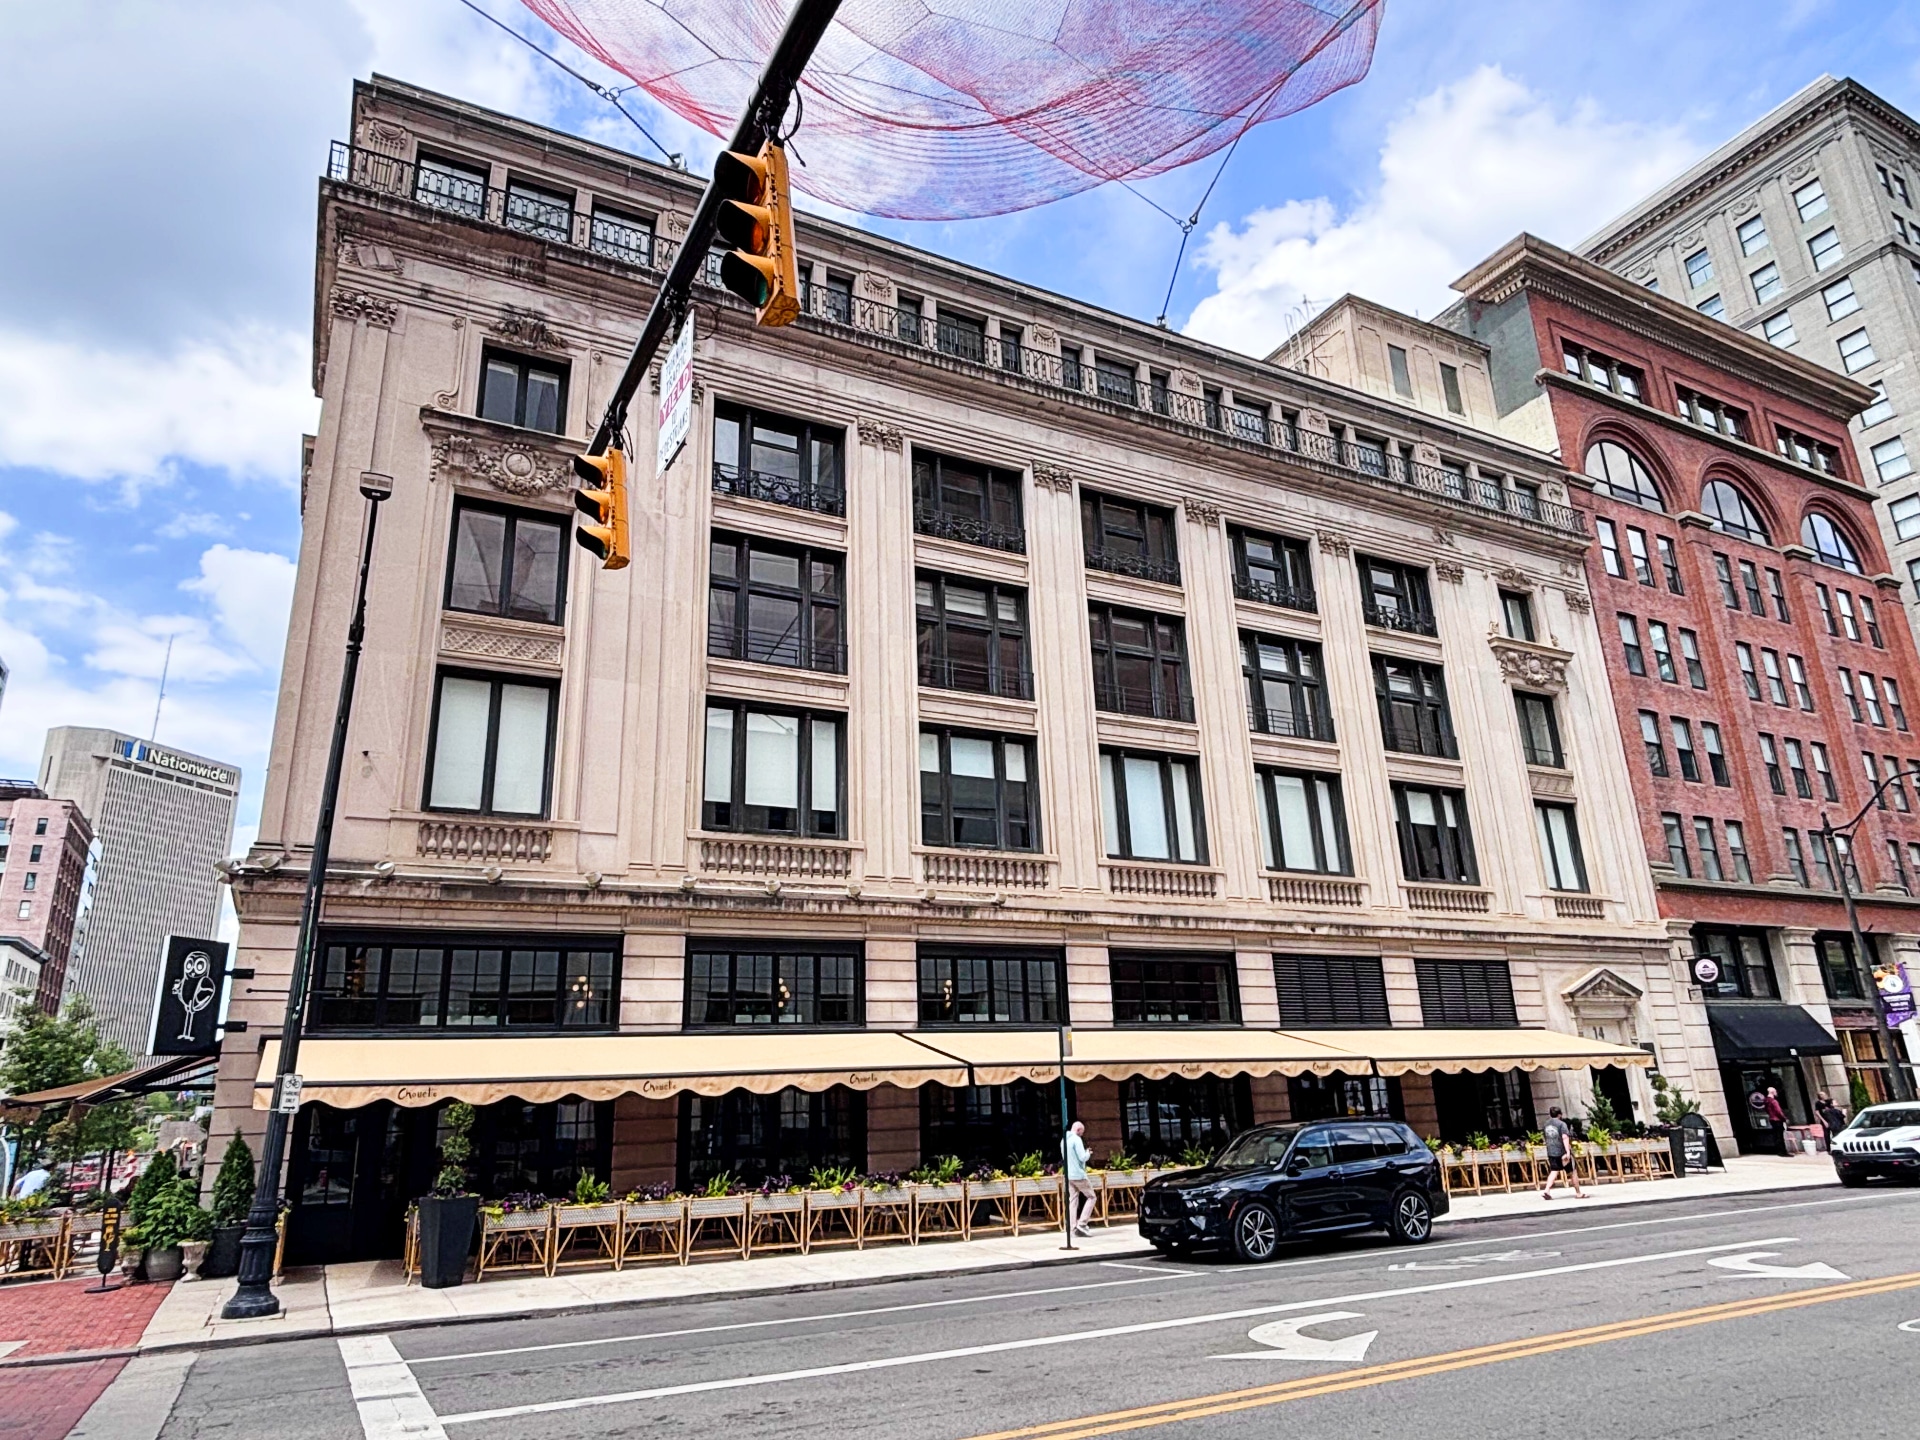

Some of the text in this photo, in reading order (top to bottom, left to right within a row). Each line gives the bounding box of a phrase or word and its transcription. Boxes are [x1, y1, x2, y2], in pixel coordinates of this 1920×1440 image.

[662, 367, 689, 422] YIELD
[148, 749, 227, 782] Nationwide
[1593, 1026, 1604, 1039] 14
